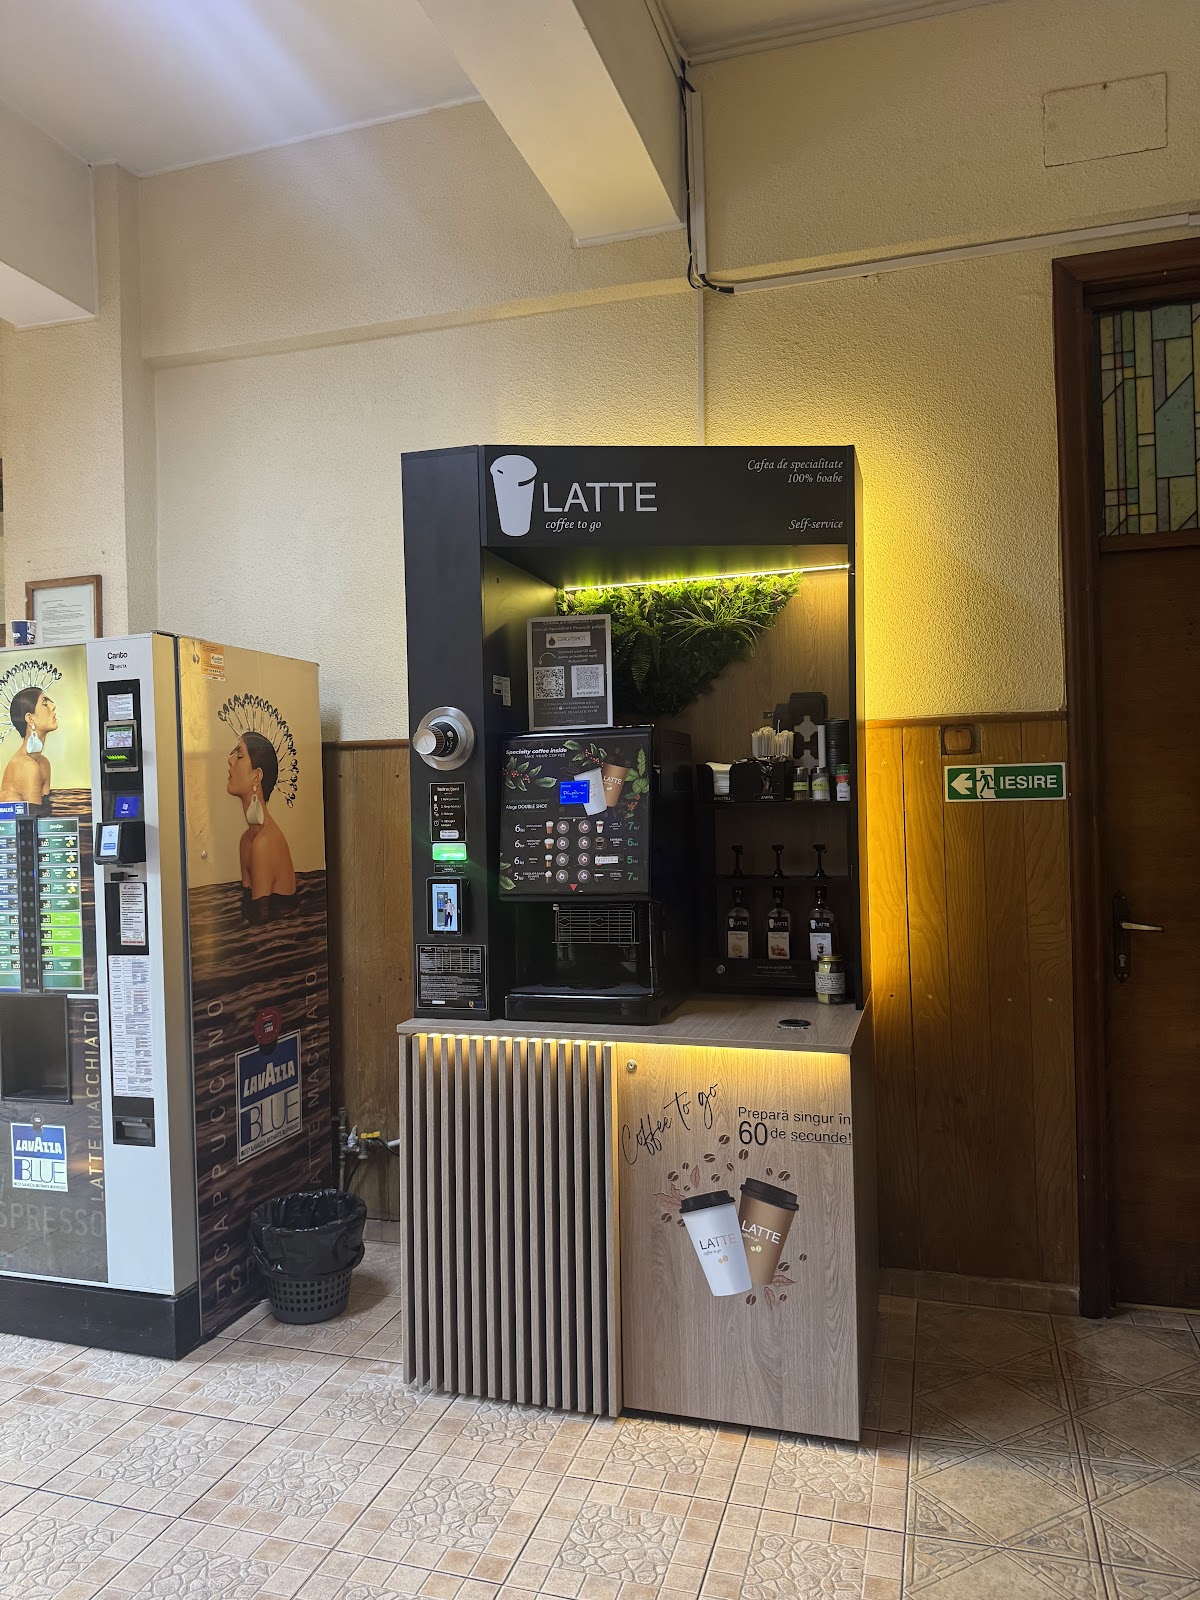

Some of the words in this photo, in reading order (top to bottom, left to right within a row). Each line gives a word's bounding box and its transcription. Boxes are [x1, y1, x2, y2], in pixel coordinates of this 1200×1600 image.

[747, 458, 775, 473] Cafea
[777, 458, 788, 469] de
[790, 458, 843, 472] specialitate
[788, 473, 814, 483] 100%
[816, 471, 843, 483] boabe
[543, 482, 658, 512] LATTE
[545, 518, 575, 532] coffee
[577, 519, 588, 529] to
[589, 519, 602, 532] go
[788, 517, 843, 532] Self-service
[107, 651, 128, 660] Canto
[603, 775, 622, 785] LATTE
[1000, 774, 1058, 790] IESIRE
[83, 1011, 102, 1129] MACCHIATO
[243, 1060, 296, 1098] LAVAZZA
[241, 1086, 299, 1147] BLUE
[622, 1113, 673, 1165] Coffee
[663, 1091, 691, 1130] to
[698, 1083, 718, 1130] go
[738, 1106, 789, 1122] Prepară
[793, 1111, 834, 1126] singur
[838, 1112, 851, 1125] în
[207, 999, 230, 1262] CAPPUCCINO
[739, 1120, 768, 1146] 60
[770, 1127, 786, 1139] de
[790, 1131, 852, 1145] secunde!
[16, 1136, 62, 1155] LAVAZZA
[14, 1158, 66, 1185] BLUE
[88, 1139, 104, 1201] LATTE
[699, 1233, 737, 1250] LATTE
[741, 1220, 781, 1244] LATTE
